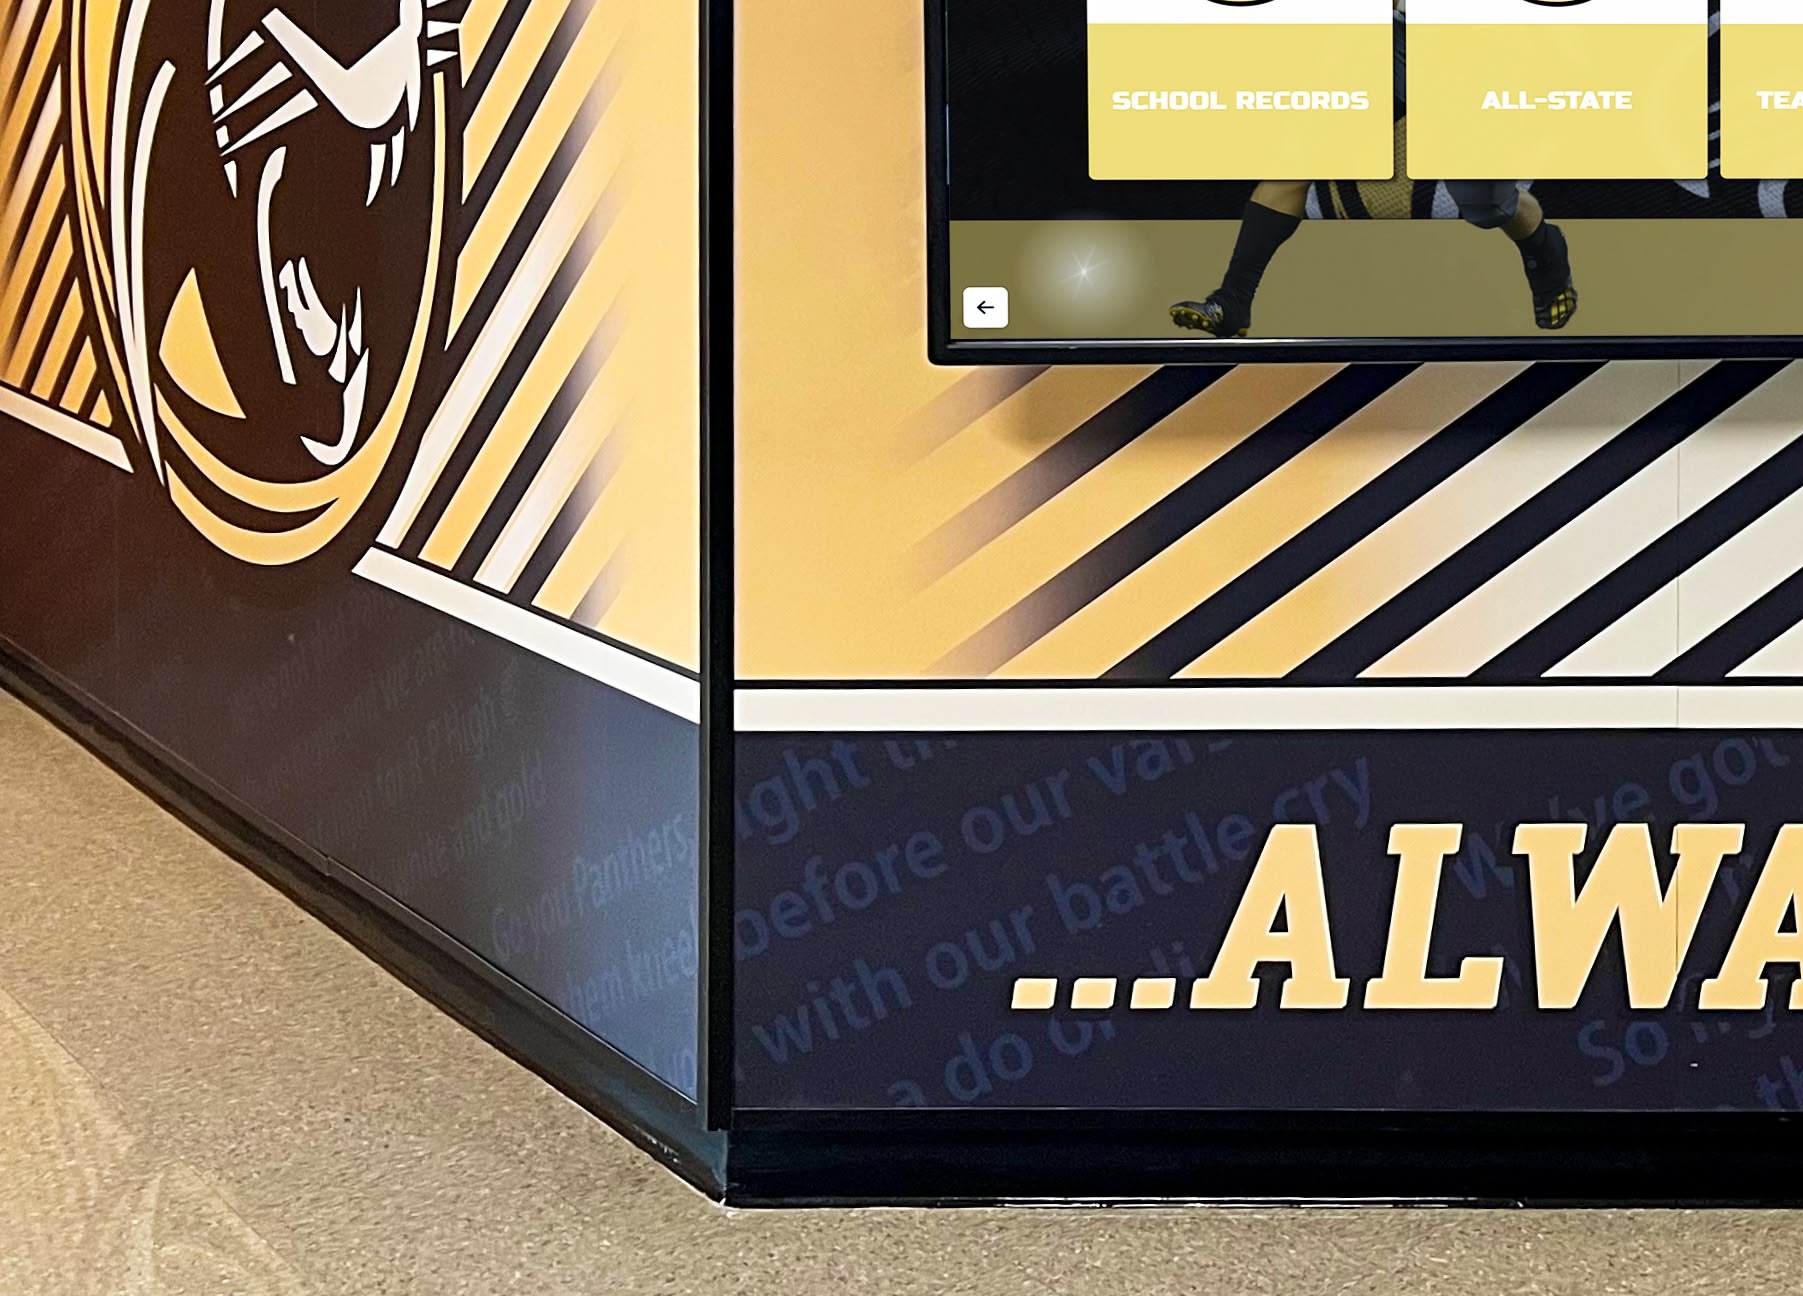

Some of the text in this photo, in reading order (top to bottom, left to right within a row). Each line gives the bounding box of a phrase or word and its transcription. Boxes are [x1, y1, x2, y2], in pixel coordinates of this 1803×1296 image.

[1112, 90, 1370, 111] SCHOOL RECORDS
[1480, 90, 1634, 111] ALL-STATE
[959, 768, 1074, 855] our
[751, 957, 914, 1065] with
[923, 903, 1038, 990] our
[1044, 810, 1256, 935] battle
[942, 1029, 1034, 1103] do
